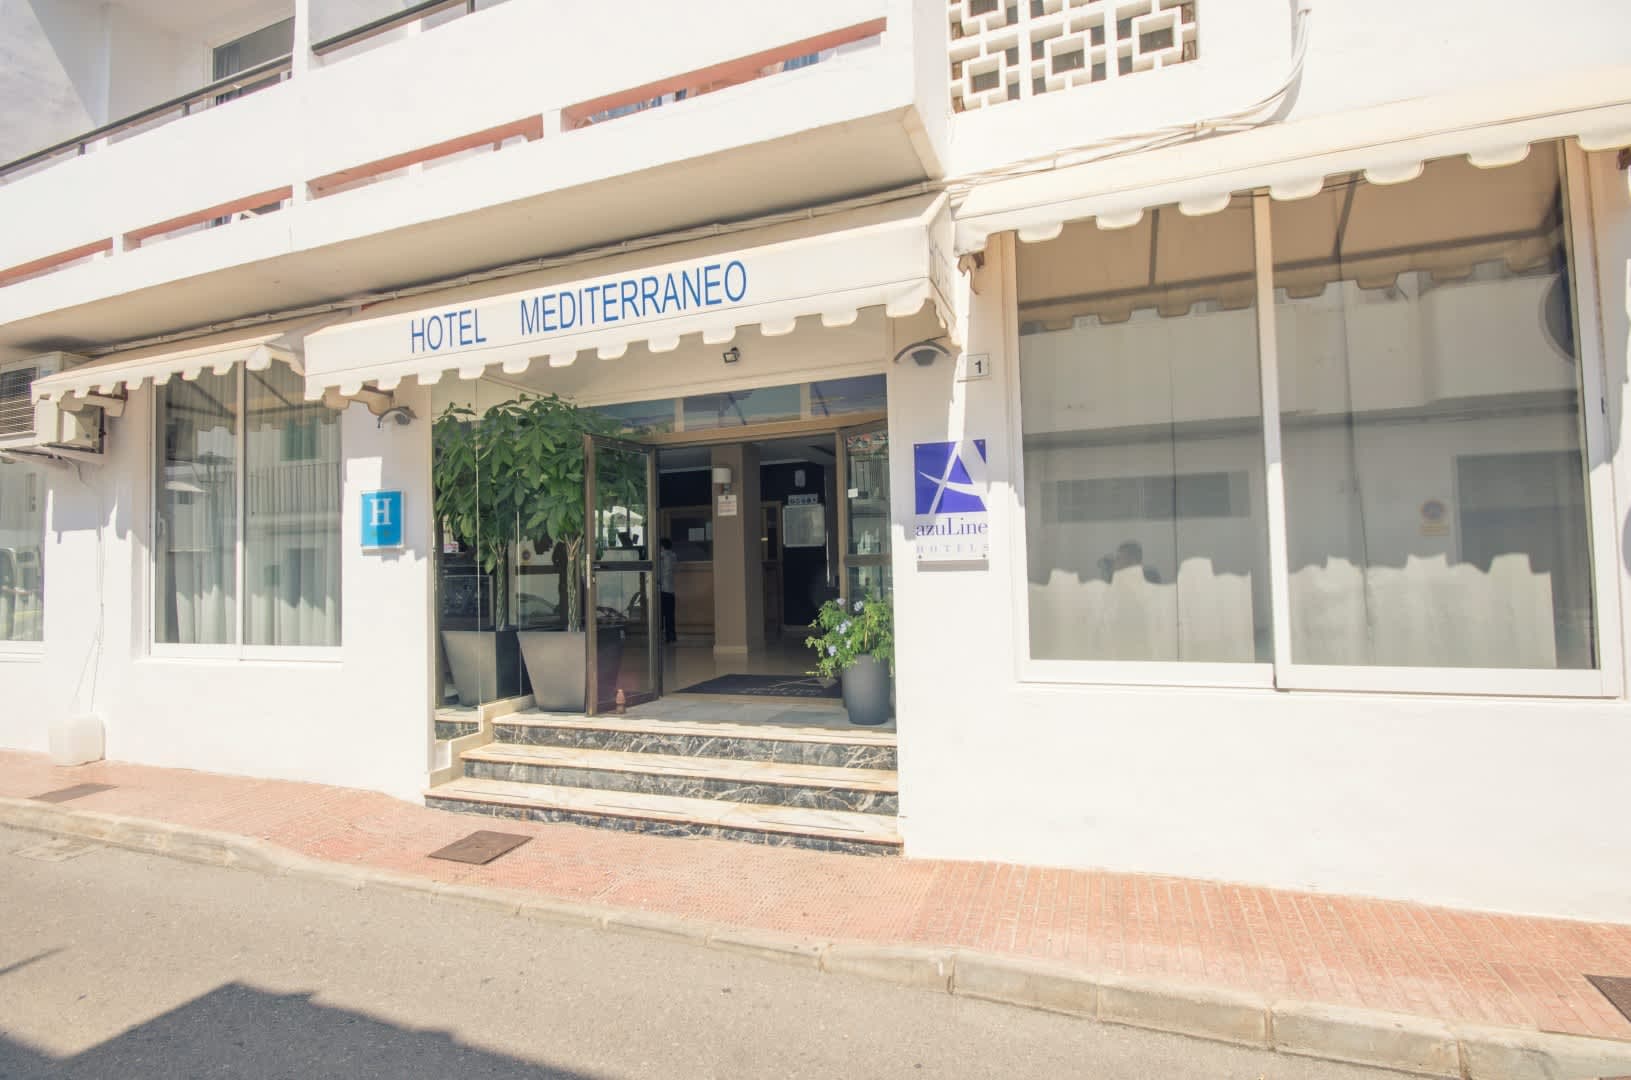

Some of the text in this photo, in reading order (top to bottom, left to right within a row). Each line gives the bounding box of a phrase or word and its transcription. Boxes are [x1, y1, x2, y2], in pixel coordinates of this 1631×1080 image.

[411, 260, 747, 354] HOTEL MEDITERRANEO
[974, 360, 983, 374] 1
[369, 498, 393, 526] H
[915, 517, 989, 537] azuLine
